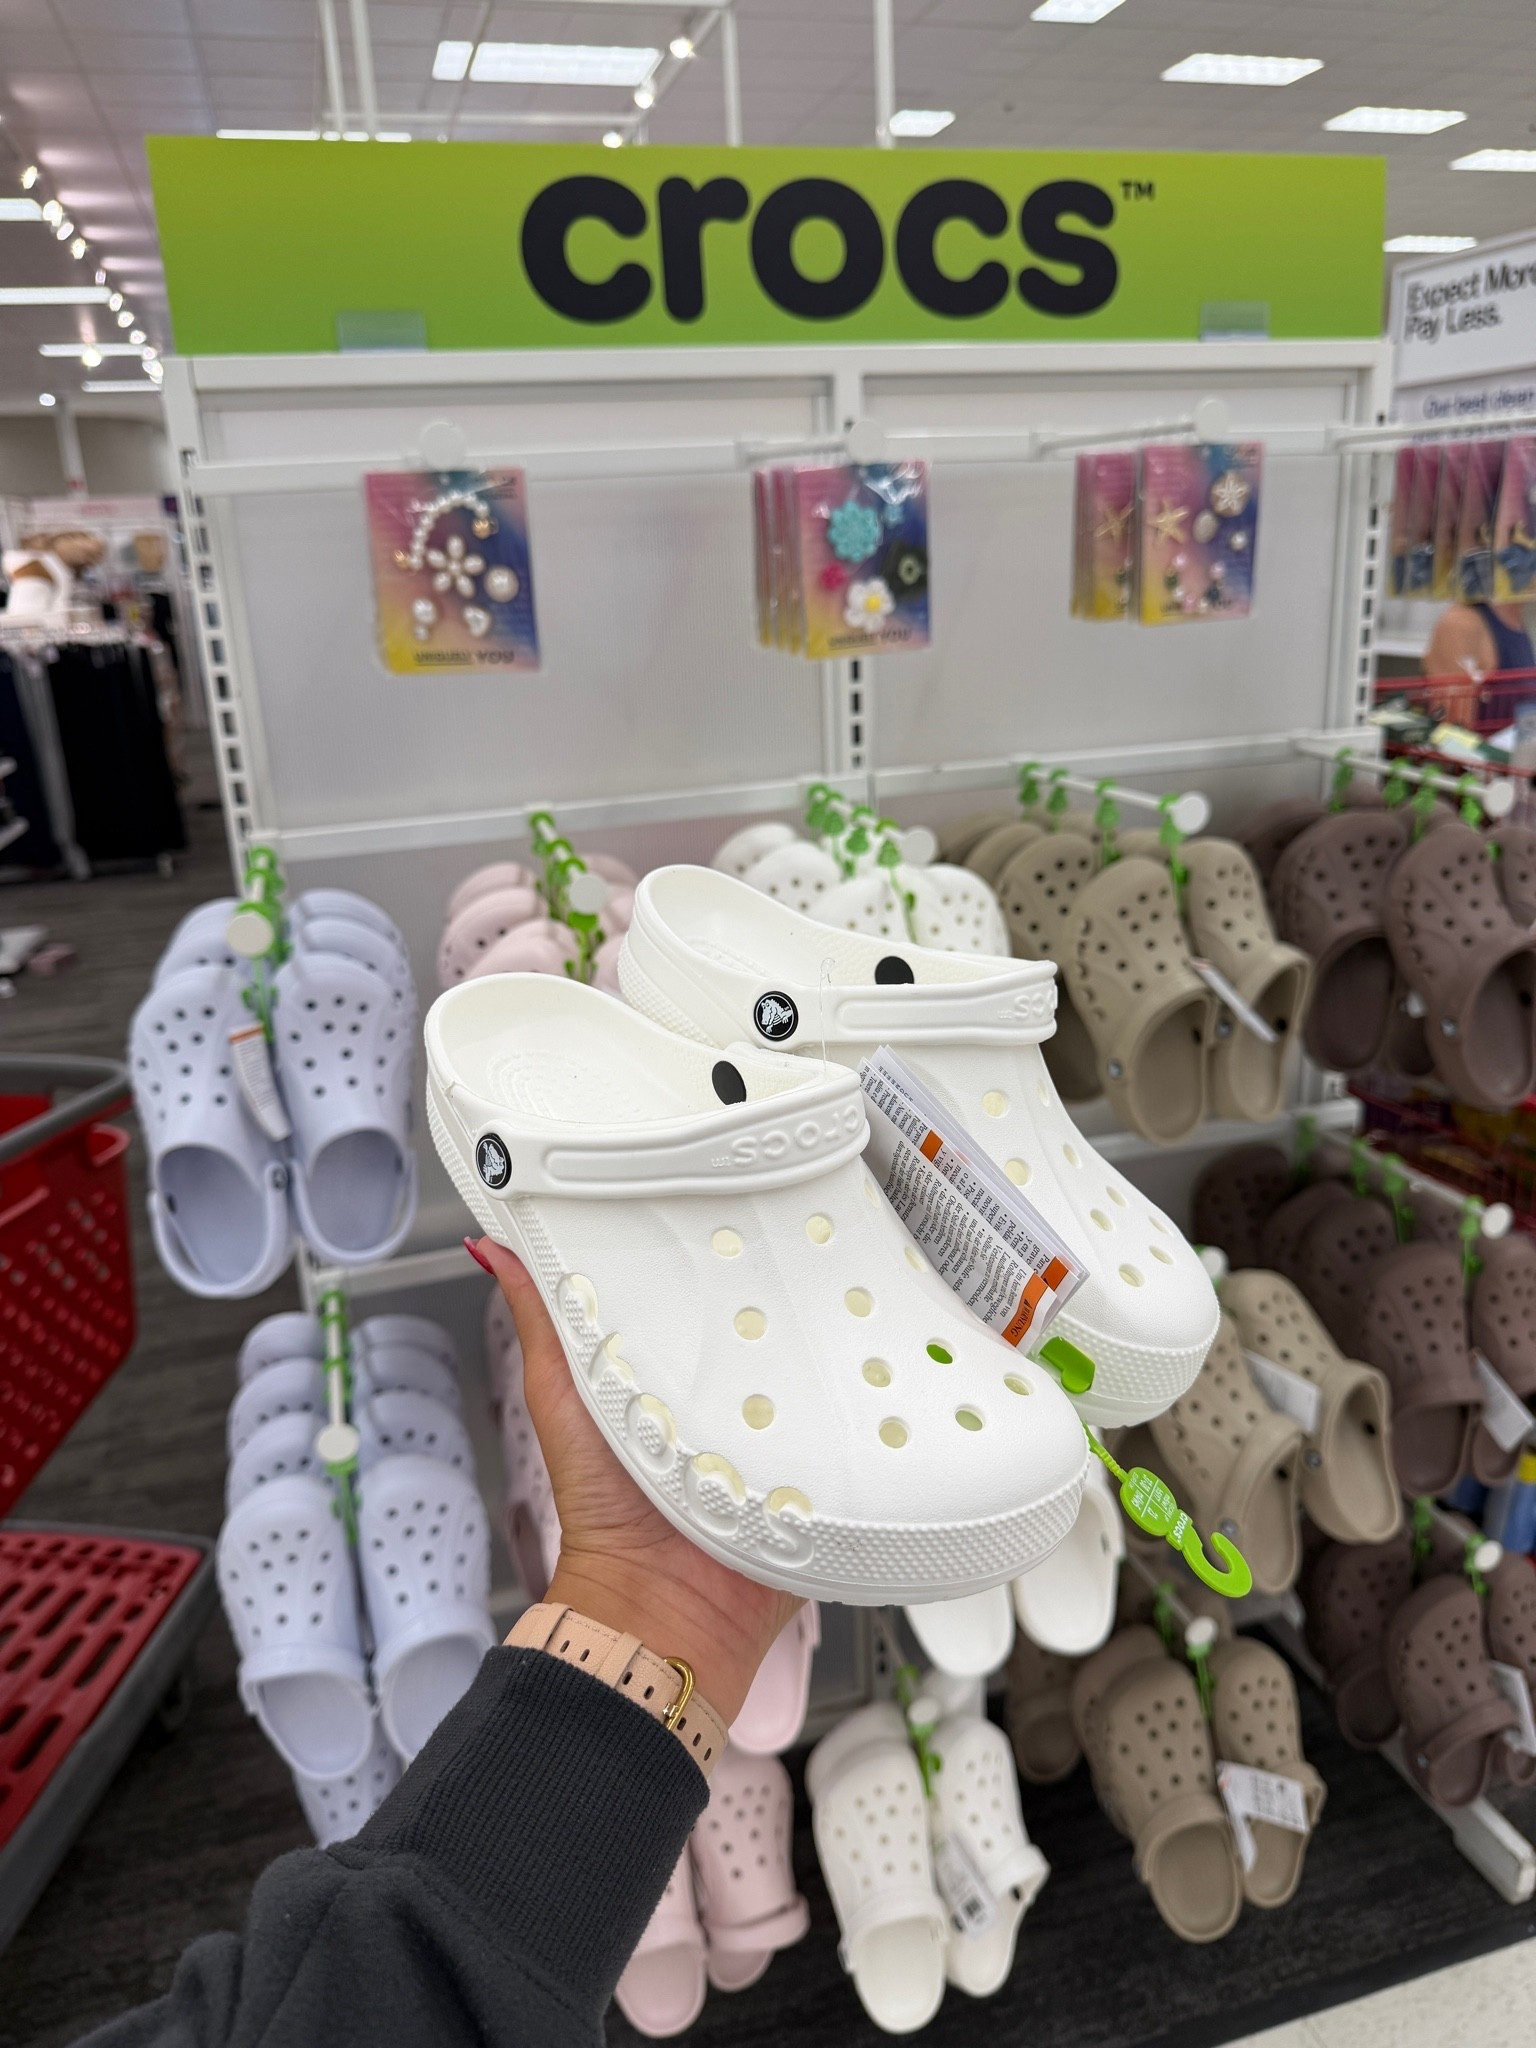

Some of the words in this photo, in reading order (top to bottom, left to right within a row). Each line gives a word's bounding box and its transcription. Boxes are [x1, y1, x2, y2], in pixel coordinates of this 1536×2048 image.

[1406, 272, 1480, 314] Expect
[1403, 316, 1442, 344] Pay
[924, 1170, 932, 1185] oder
[958, 1177, 965, 1187] al
[954, 1202, 963, 1213] der
[968, 1218, 978, 1233] und
[922, 1232, 931, 1244] die
[1020, 1242, 1028, 1252] en
[937, 1259, 949, 1278] oder
[1036, 1253, 1049, 1269] Para
[961, 1261, 974, 1278] Stufe
[1015, 1268, 1026, 1281] Um
[999, 1305, 1010, 1317] von
